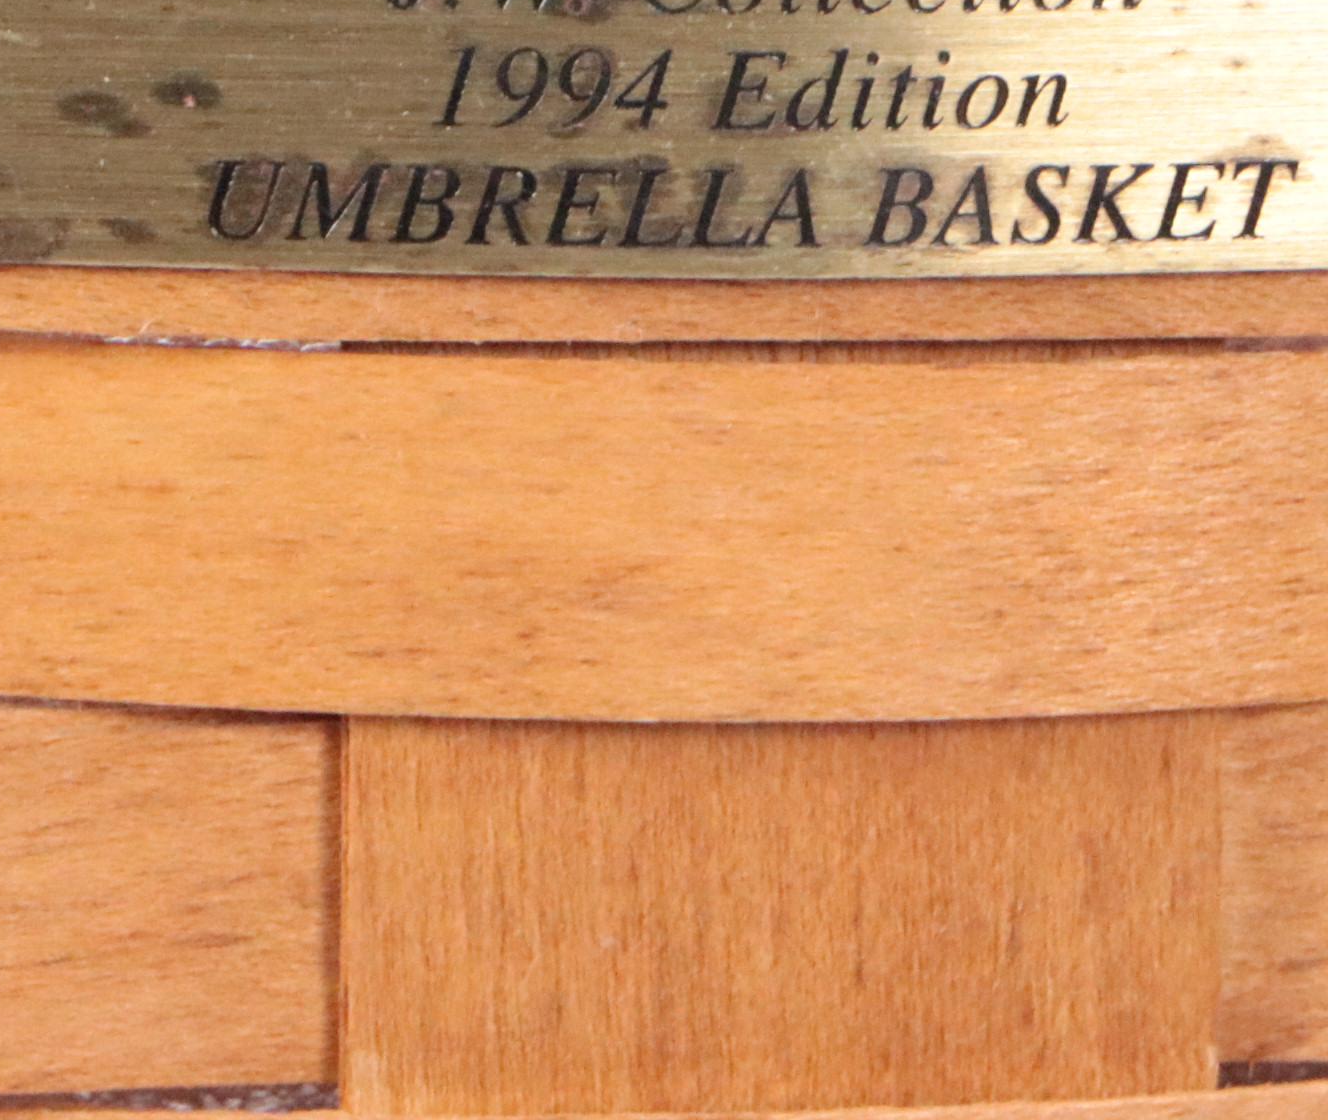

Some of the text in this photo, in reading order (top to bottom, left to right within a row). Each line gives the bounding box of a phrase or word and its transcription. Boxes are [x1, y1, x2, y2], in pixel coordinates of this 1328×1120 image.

[432, 46, 1070, 132] 1994 Edition
[206, 159, 1300, 249] UMBRELLA BASKET
